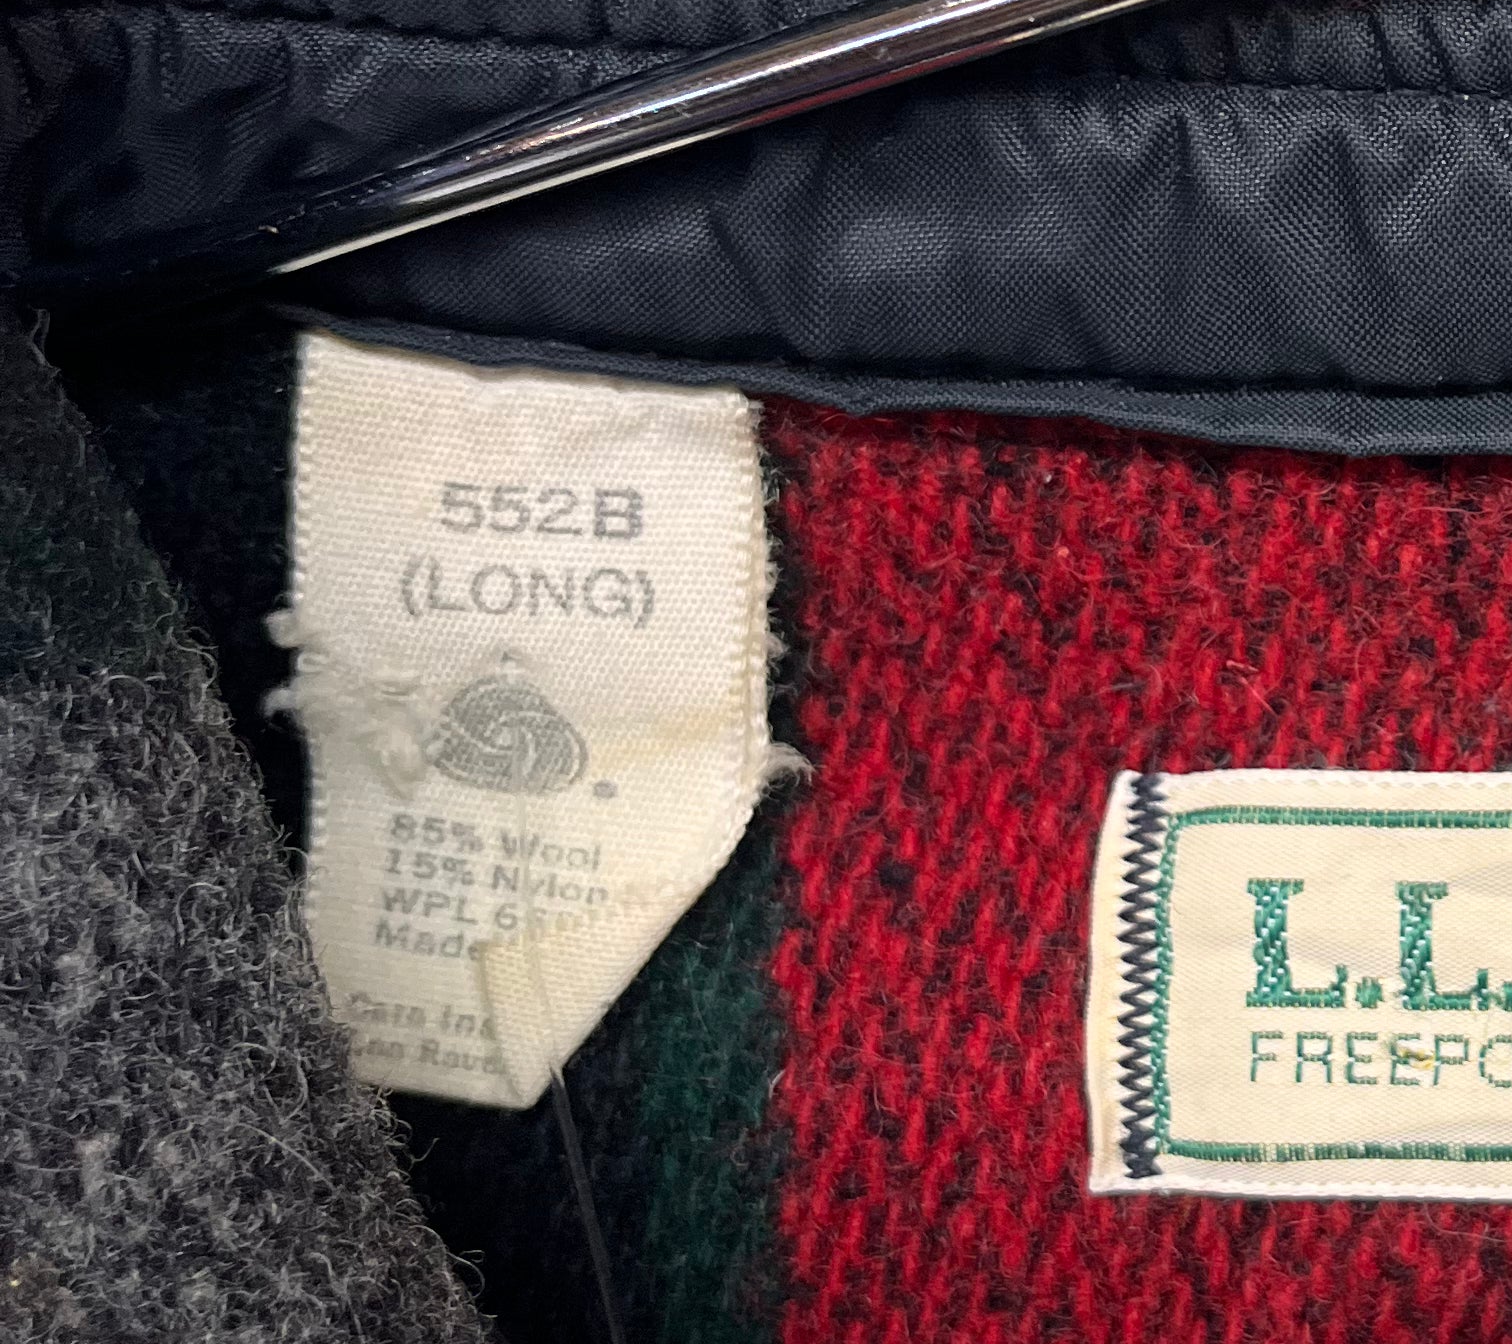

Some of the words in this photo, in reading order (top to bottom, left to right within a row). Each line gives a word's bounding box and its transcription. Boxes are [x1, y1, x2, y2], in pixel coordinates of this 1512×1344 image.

[440, 481, 644, 540] 552B
[401, 555, 656, 629] (LONG)
[390, 813, 485, 853] 85%
[500, 830, 601, 870] Wool
[386, 848, 475, 887] 15%
[491, 864, 608, 904] Nylon
[382, 888, 478, 926] WPL
